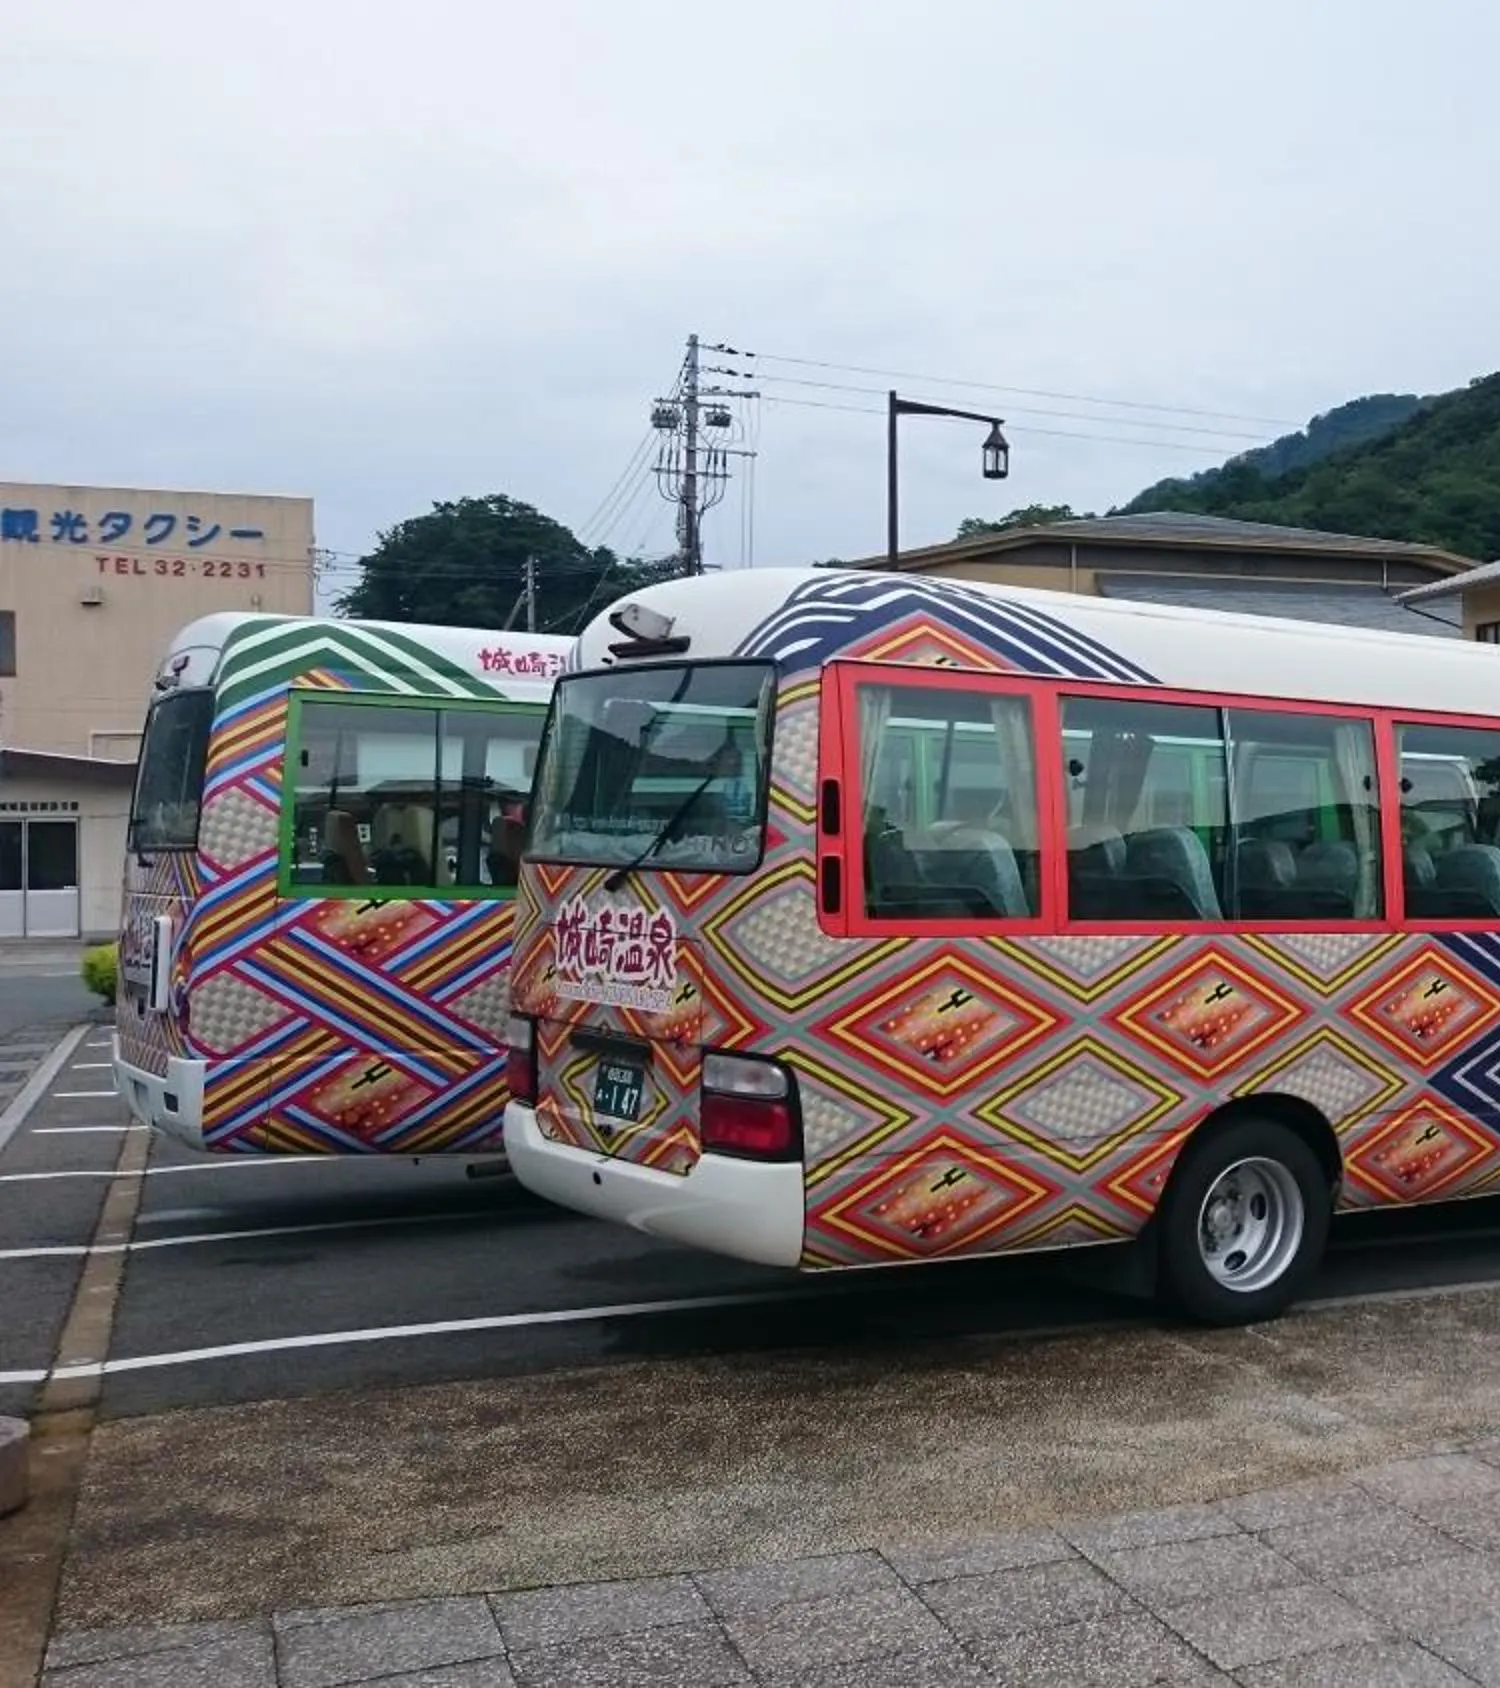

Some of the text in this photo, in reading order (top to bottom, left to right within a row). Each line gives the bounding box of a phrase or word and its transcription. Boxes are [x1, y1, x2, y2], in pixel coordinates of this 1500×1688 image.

[96, 556, 146, 576] TEL
[556, 901, 676, 986] 城崎温泉
